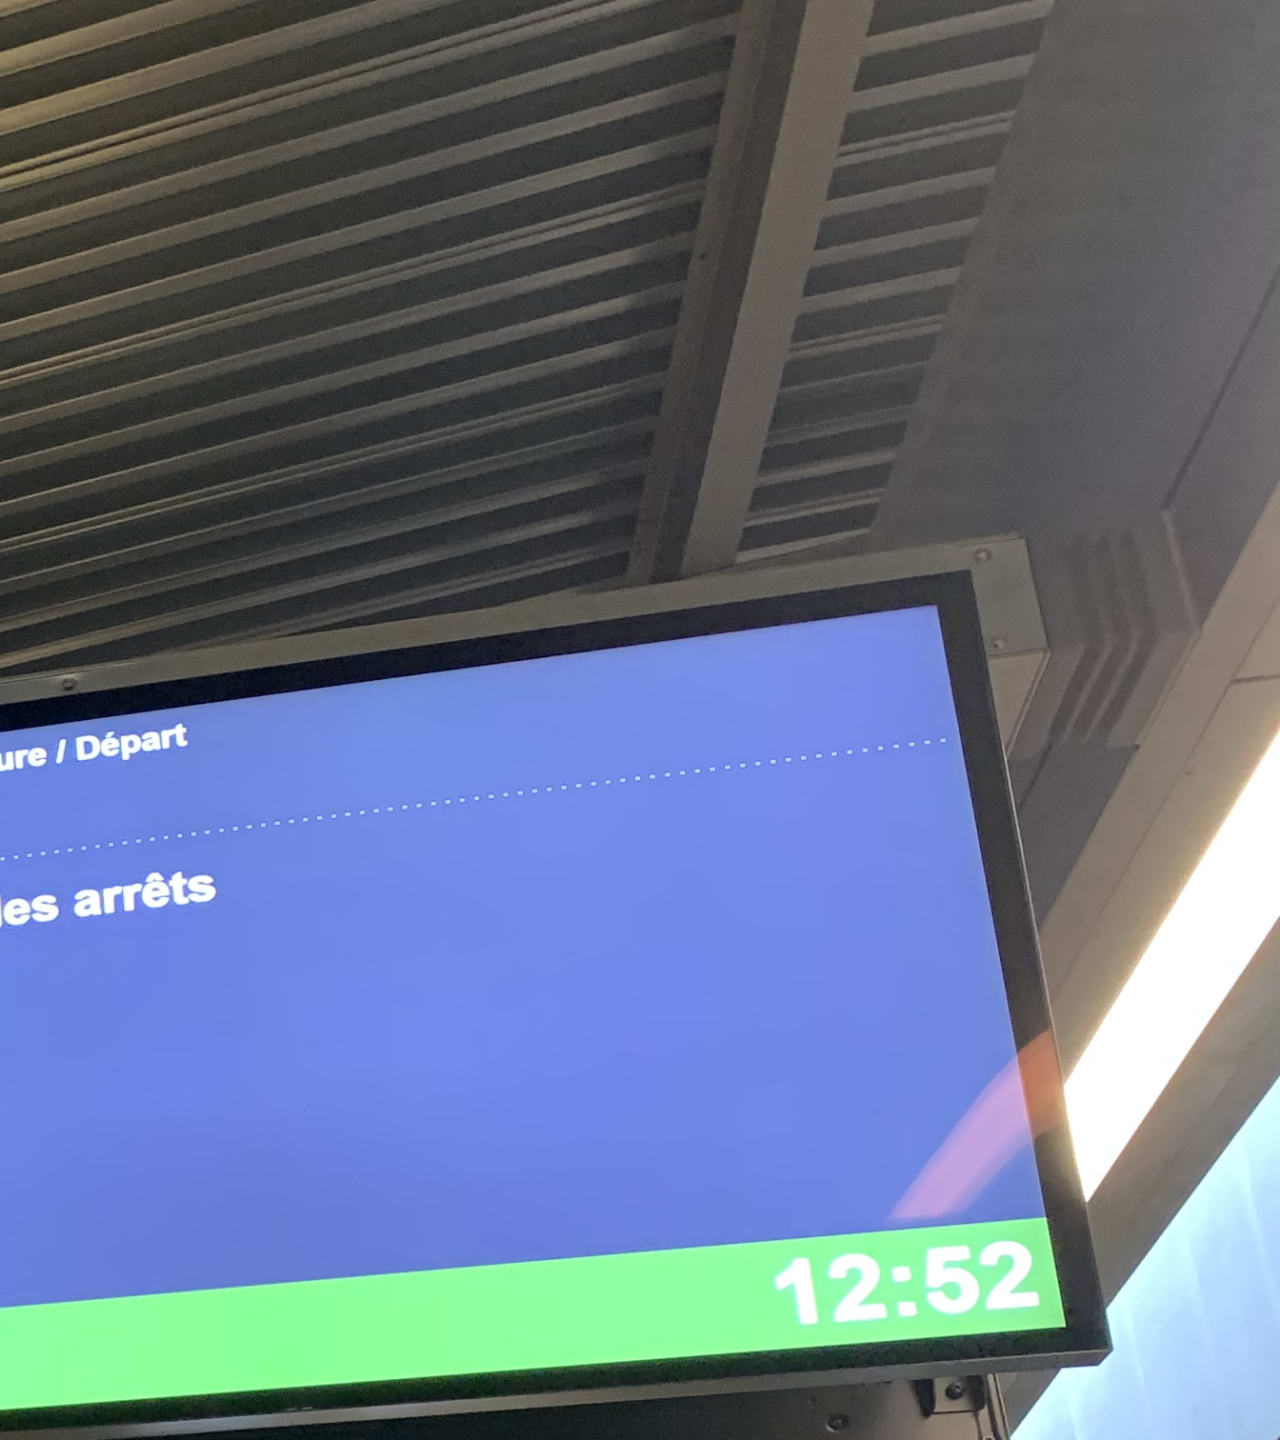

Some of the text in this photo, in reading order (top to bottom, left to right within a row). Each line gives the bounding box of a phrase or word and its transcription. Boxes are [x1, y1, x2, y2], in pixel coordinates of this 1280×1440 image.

[56, 740, 67, 766] /
[75, 723, 188, 761] Départ
[74, 871, 217, 918] arrêts
[775, 1240, 1040, 1325] 12:52
